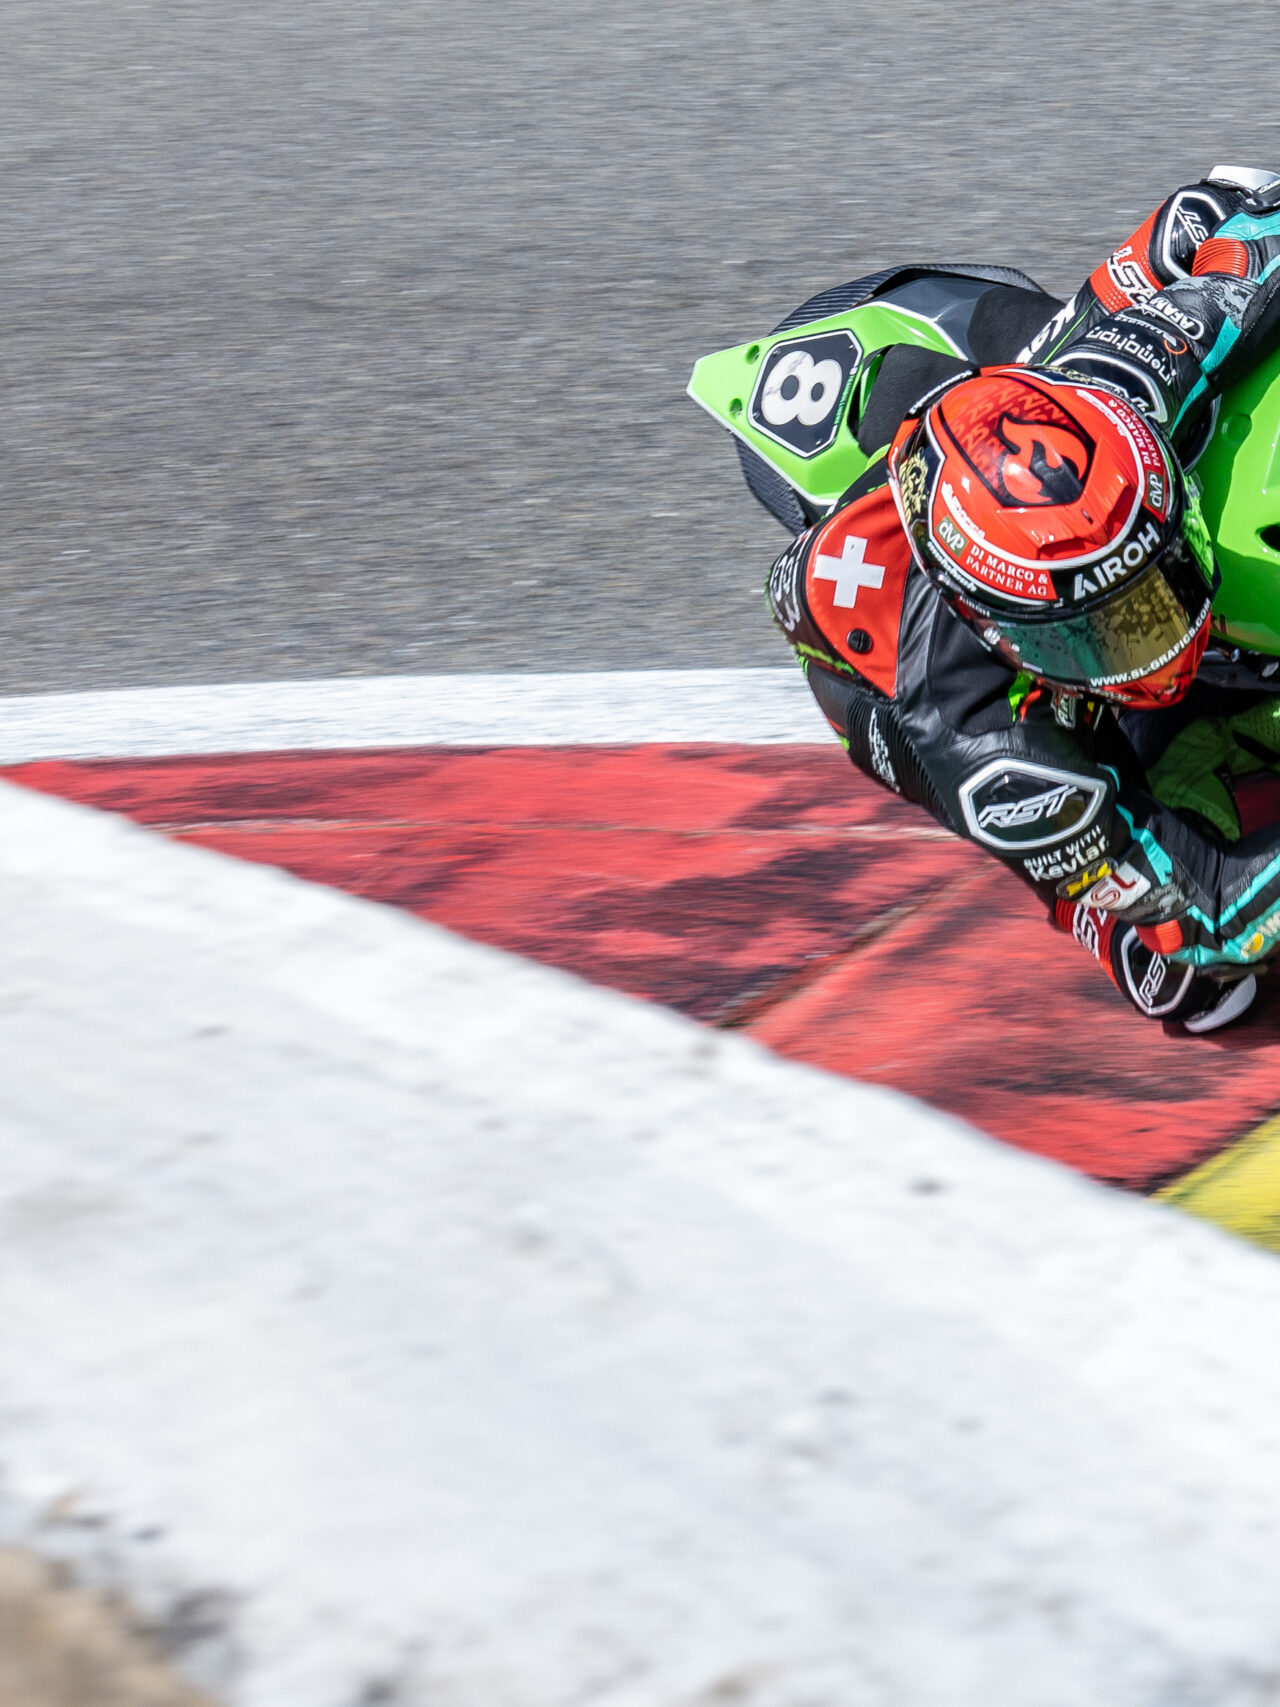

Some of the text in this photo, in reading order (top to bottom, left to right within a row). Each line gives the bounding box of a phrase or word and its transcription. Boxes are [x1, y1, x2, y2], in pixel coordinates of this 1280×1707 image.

[1144, 293, 1198, 330] AFAM
[762, 351, 842, 426] 8
[964, 556, 1023, 593] PARTNER
[986, 552, 1037, 584] MARCO
[1074, 520, 1161, 601] AIROH
[977, 785, 1078, 829] RST
[1024, 825, 1103, 871] BUILT WITH
